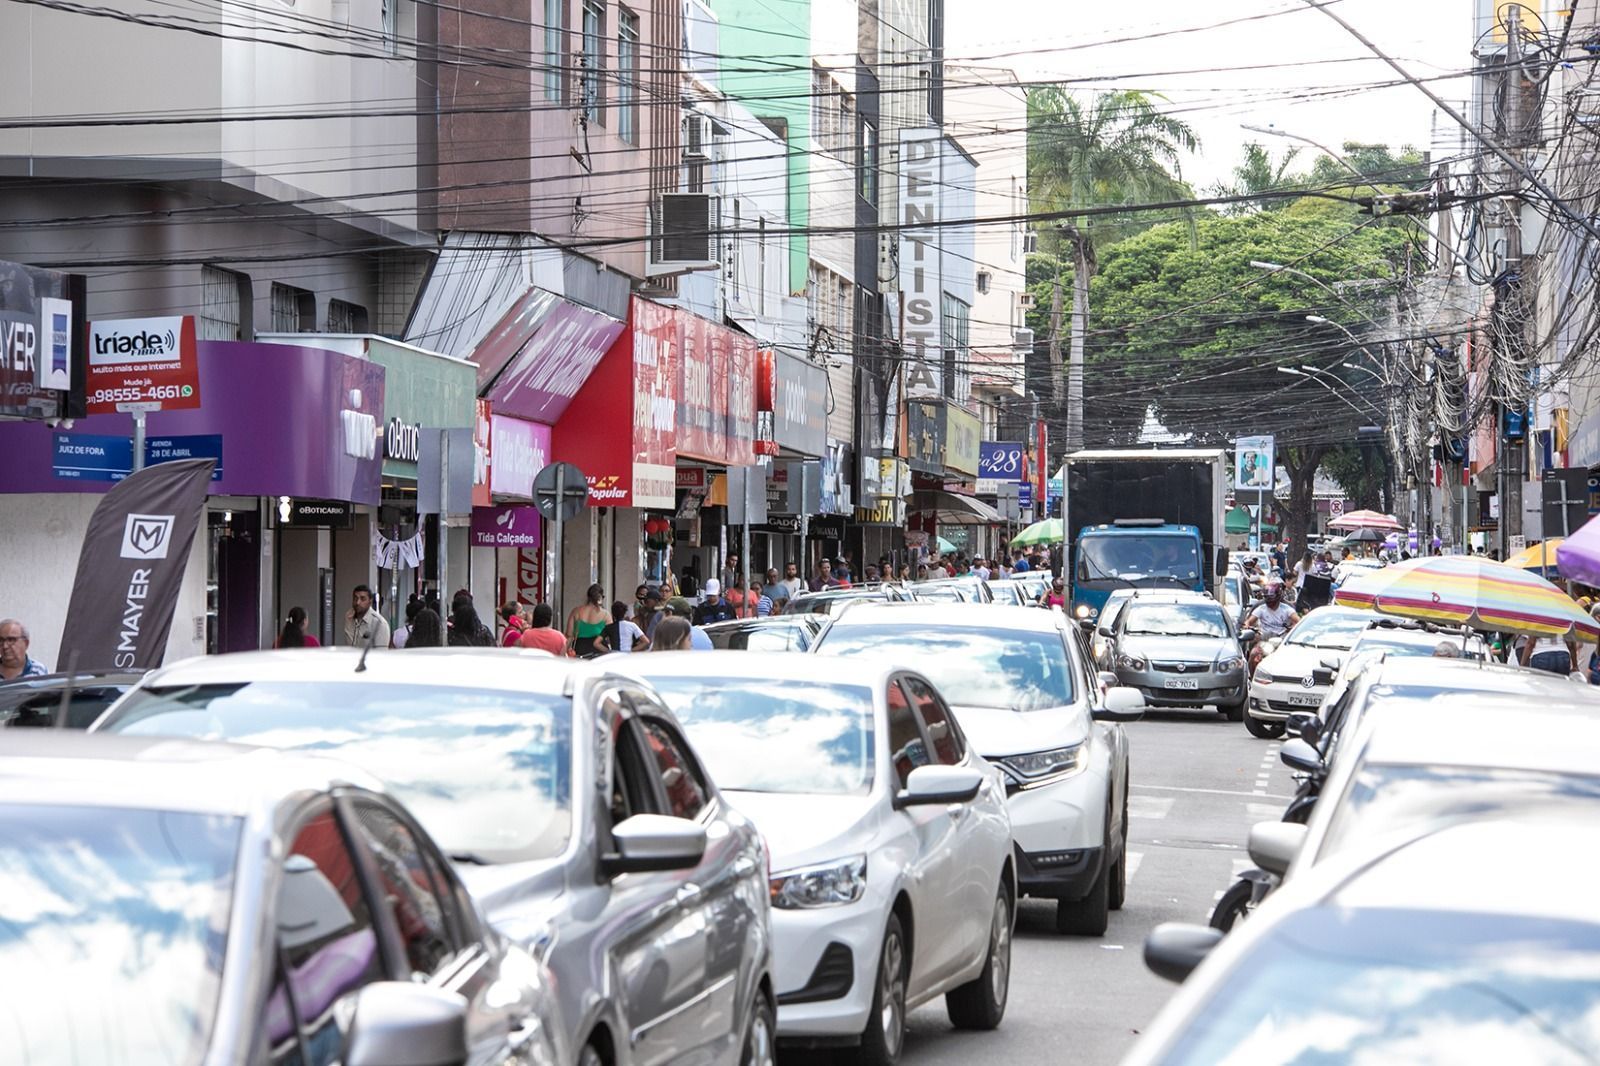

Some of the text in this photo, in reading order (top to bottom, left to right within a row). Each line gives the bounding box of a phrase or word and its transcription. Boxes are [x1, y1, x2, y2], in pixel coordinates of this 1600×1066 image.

[905, 140, 937, 390] DENTISTA
[95, 331, 162, 354] tríade
[58, 445, 105, 456] JUIZ DE FORA
[172, 449, 192, 457] ABRIL
[988, 450, 1020, 473] 28
[588, 486, 628, 500] Popular
[477, 532, 534, 546] Tida Calçados
[115, 568, 152, 668] SMAYER
